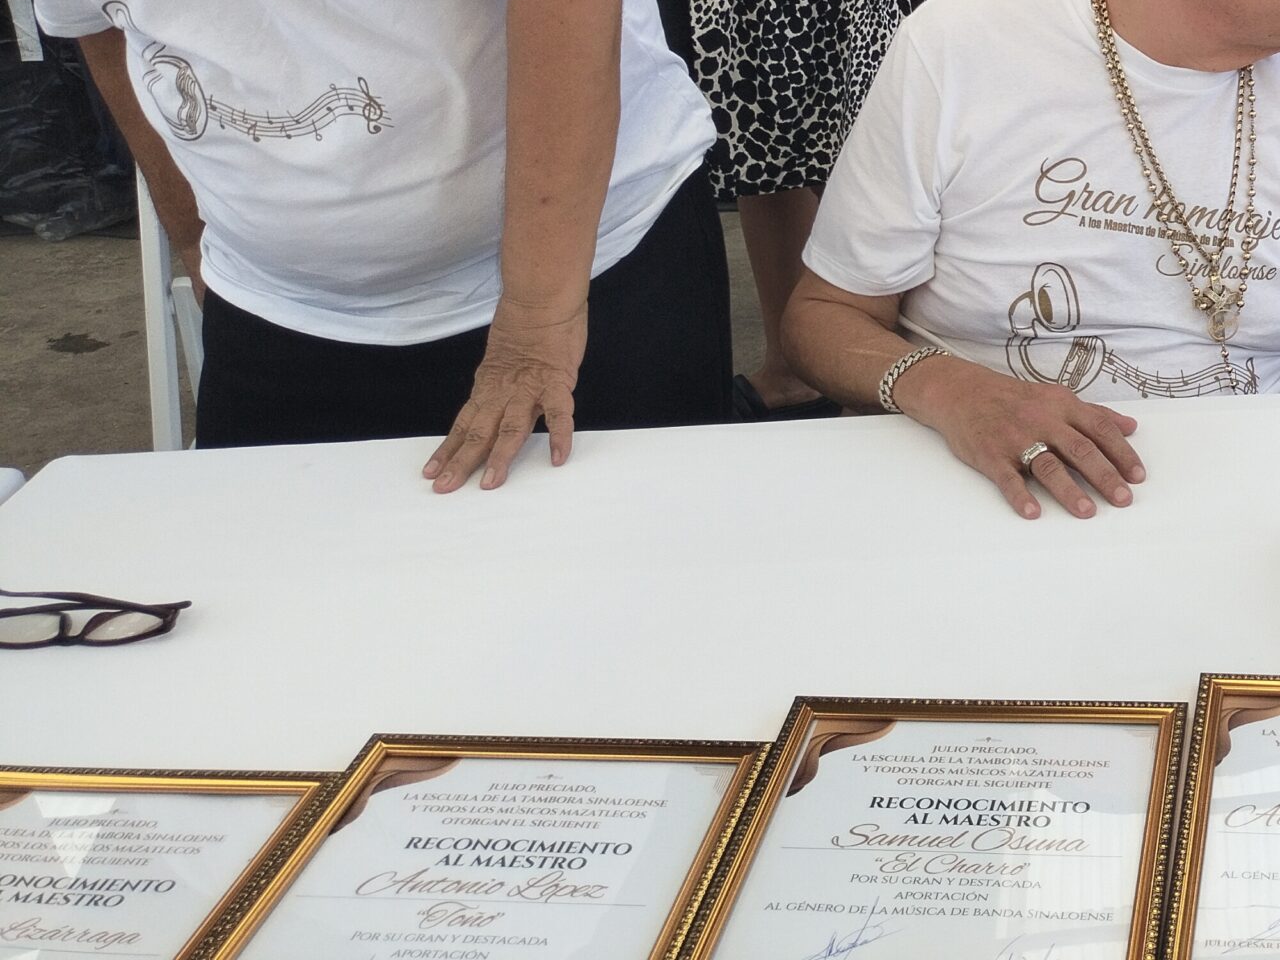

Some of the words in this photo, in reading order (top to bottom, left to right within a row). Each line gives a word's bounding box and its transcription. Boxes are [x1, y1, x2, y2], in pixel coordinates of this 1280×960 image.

[1022, 157, 1139, 226] Gran
[1079, 216, 1086, 227] A
[1088, 217, 1102, 229] los
[1103, 221, 1144, 235] Maestros
[1145, 225, 1156, 237] de
[931, 745, 968, 753] JULIO
[971, 746, 1039, 755] PRECIADO,
[852, 754, 868, 762] LA
[870, 754, 926, 763] ESCUELA
[949, 756, 964, 764] LA
[967, 757, 1028, 766] TAMBORA
[1031, 758, 1111, 768] SINALOENSE
[863, 765, 870, 773] Y
[874, 766, 918, 774] TODOS
[921, 767, 945, 775] LOS
[948, 767, 1006, 777] MÚSICOS
[1009, 769, 1095, 778] MAZATLECOS
[488, 783, 527, 792] JULIO
[528, 784, 597, 794] PRECIADO,
[897, 777, 964, 787] OTORGAN
[966, 779, 981, 787] EL
[983, 780, 1052, 789] SIGUIENTE
[402, 792, 419, 801] LA
[421, 793, 478, 802] ESCUELA
[481, 794, 499, 802] DE
[500, 794, 517, 803] LA
[521, 795, 584, 804] TAMBORA
[585, 797, 668, 808] SINALOENSE
[869, 796, 1091, 814] RECONOCIMIENTO
[422, 805, 468, 813] TODOS
[470, 806, 495, 814] LOS
[496, 805, 557, 816] MÚSICOS
[559, 809, 648, 819] MAZATLECOS
[441, 817, 511, 827] OTORGAN
[512, 819, 528, 827] EL
[528, 819, 602, 829] SIGUIENTE
[904, 813, 933, 825] AL
[939, 814, 1051, 828] MAESTRO
[831, 823, 969, 849] Samuel
[971, 826, 1089, 852] Osuna
[403, 837, 633, 856] RECONOCIMIENTO
[434, 854, 465, 867] AL
[469, 855, 587, 870] MAESTRO
[355, 868, 505, 896] Antonio
[507, 871, 608, 903] López
[850, 873, 878, 885] POR
[881, 875, 903, 885] SU
[904, 876, 944, 887] GRAN
[947, 877, 956, 887] Y
[958, 878, 1042, 889] DESTACADA
[8, 892, 126, 907] MAESTRO
[893, 890, 989, 902] APORTACIÓN
[764, 902, 782, 911] AL
[785, 901, 846, 914] GÉNERO
[849, 904, 868, 915] DE
[892, 904, 949, 917] MÚSICA
[951, 907, 969, 917] DE
[973, 908, 1023, 918] BANDA
[1027, 909, 1114, 922] SINALOENSE
[350, 930, 381, 941] POR
[384, 932, 404, 941] SU
[404, 933, 449, 943] GRAN
[462, 935, 549, 946] DESTACADA
[390, 948, 490, 960] APORTACIÓN
